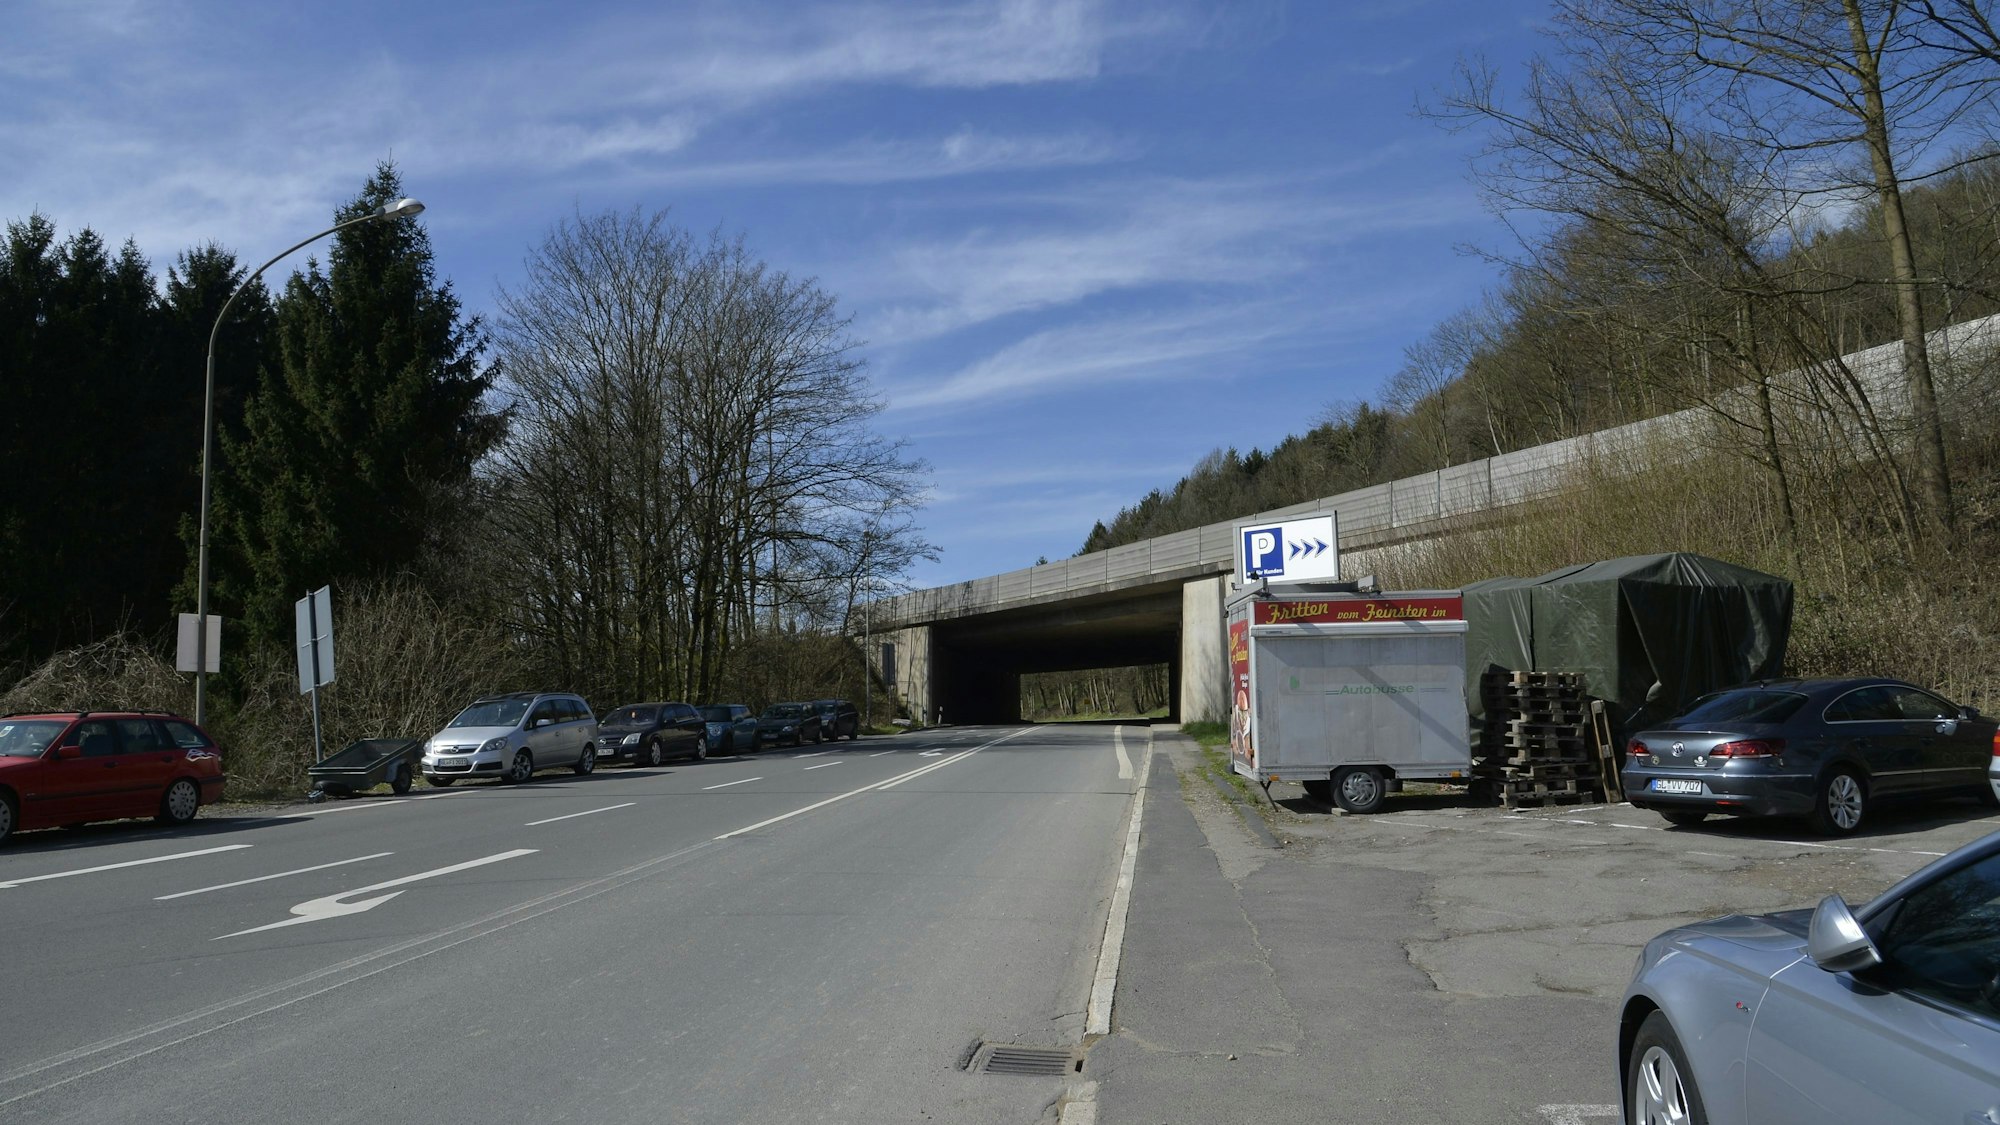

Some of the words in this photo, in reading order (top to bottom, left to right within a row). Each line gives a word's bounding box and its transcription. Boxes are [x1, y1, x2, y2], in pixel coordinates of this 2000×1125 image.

[1251, 532, 1276, 569] P
[1266, 602, 1329, 625] Fritten
[1337, 610, 1359, 619] vom
[1362, 603, 1428, 622] Feinsten
[1431, 605, 1447, 618] im
[1340, 684, 1415, 695] Autobusse
